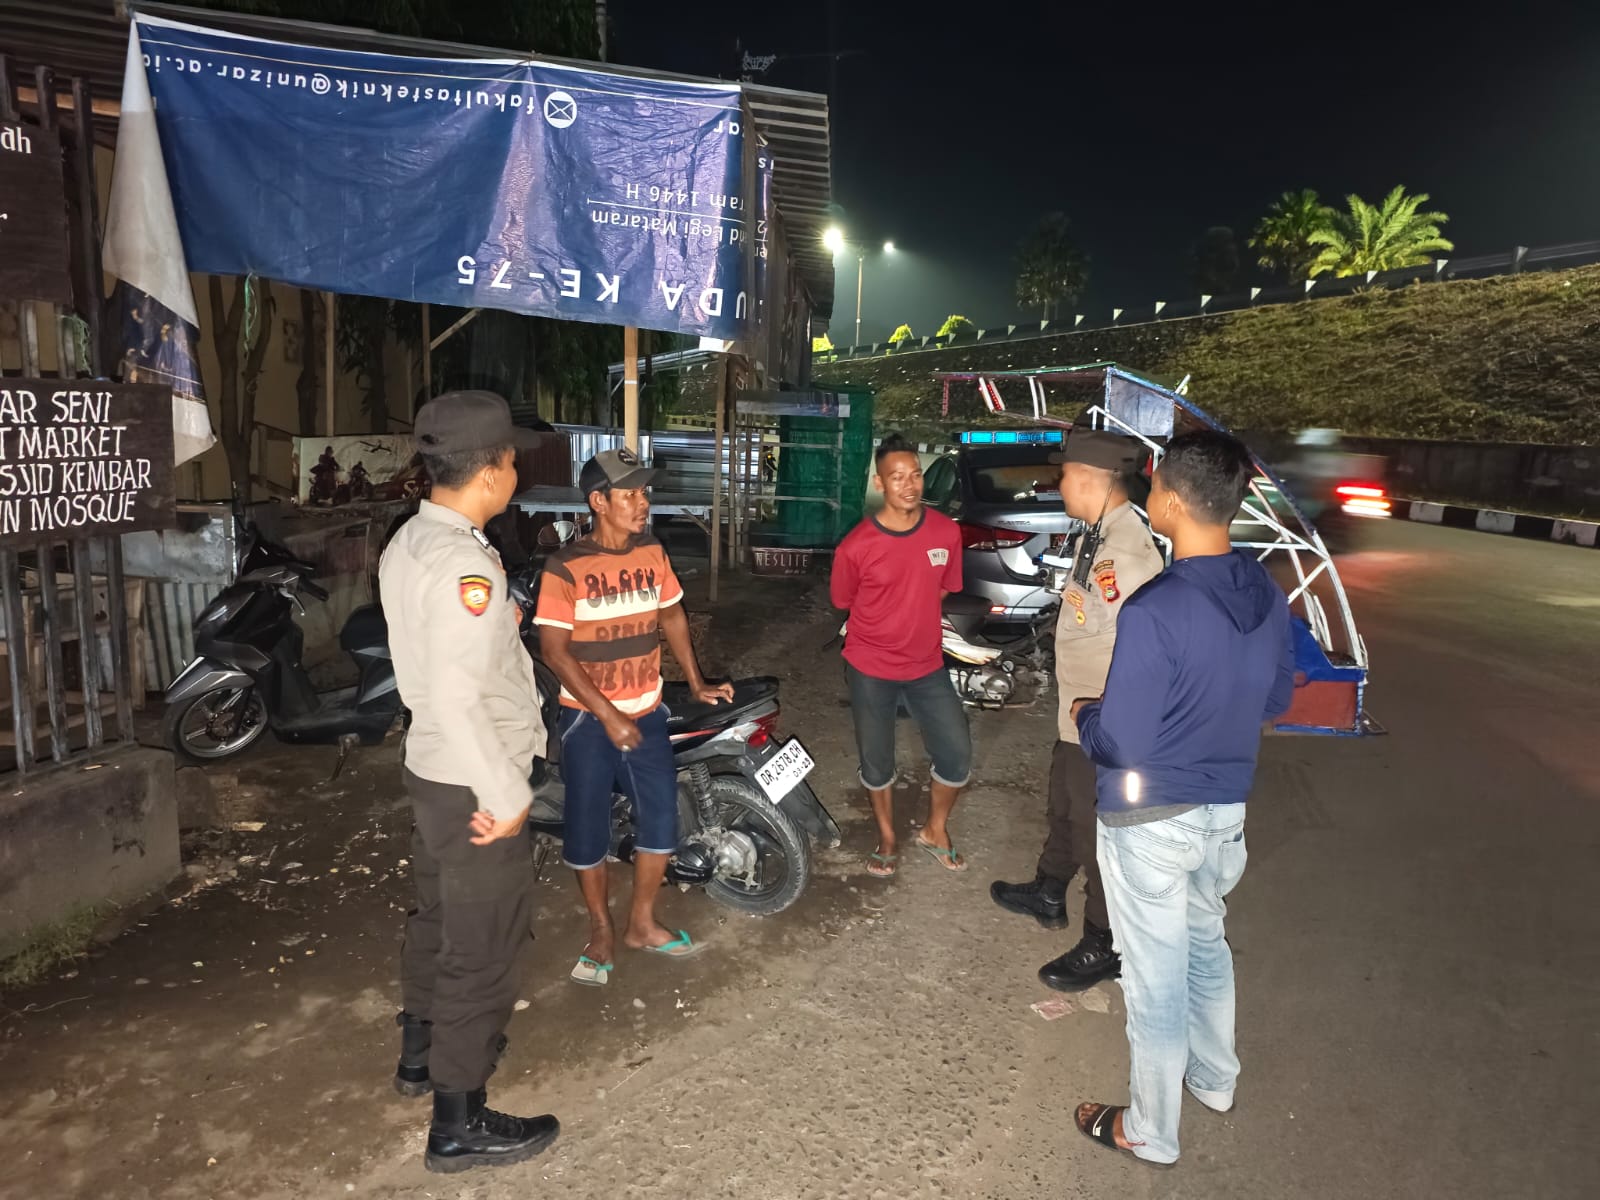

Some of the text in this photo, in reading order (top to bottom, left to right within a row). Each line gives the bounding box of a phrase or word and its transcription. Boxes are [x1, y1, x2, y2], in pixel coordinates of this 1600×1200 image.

[626, 183, 639, 200] H
[650, 184, 698, 206] 1446
[592, 209, 677, 236] Mataram
[683, 217, 723, 242] Legi
[659, 280, 747, 320] UDA
[0, 390, 112, 424] AR SENI
[18, 426, 127, 460] MARKET
[60, 458, 152, 494] KEMBAR
[29, 490, 138, 532] MOSQUE
